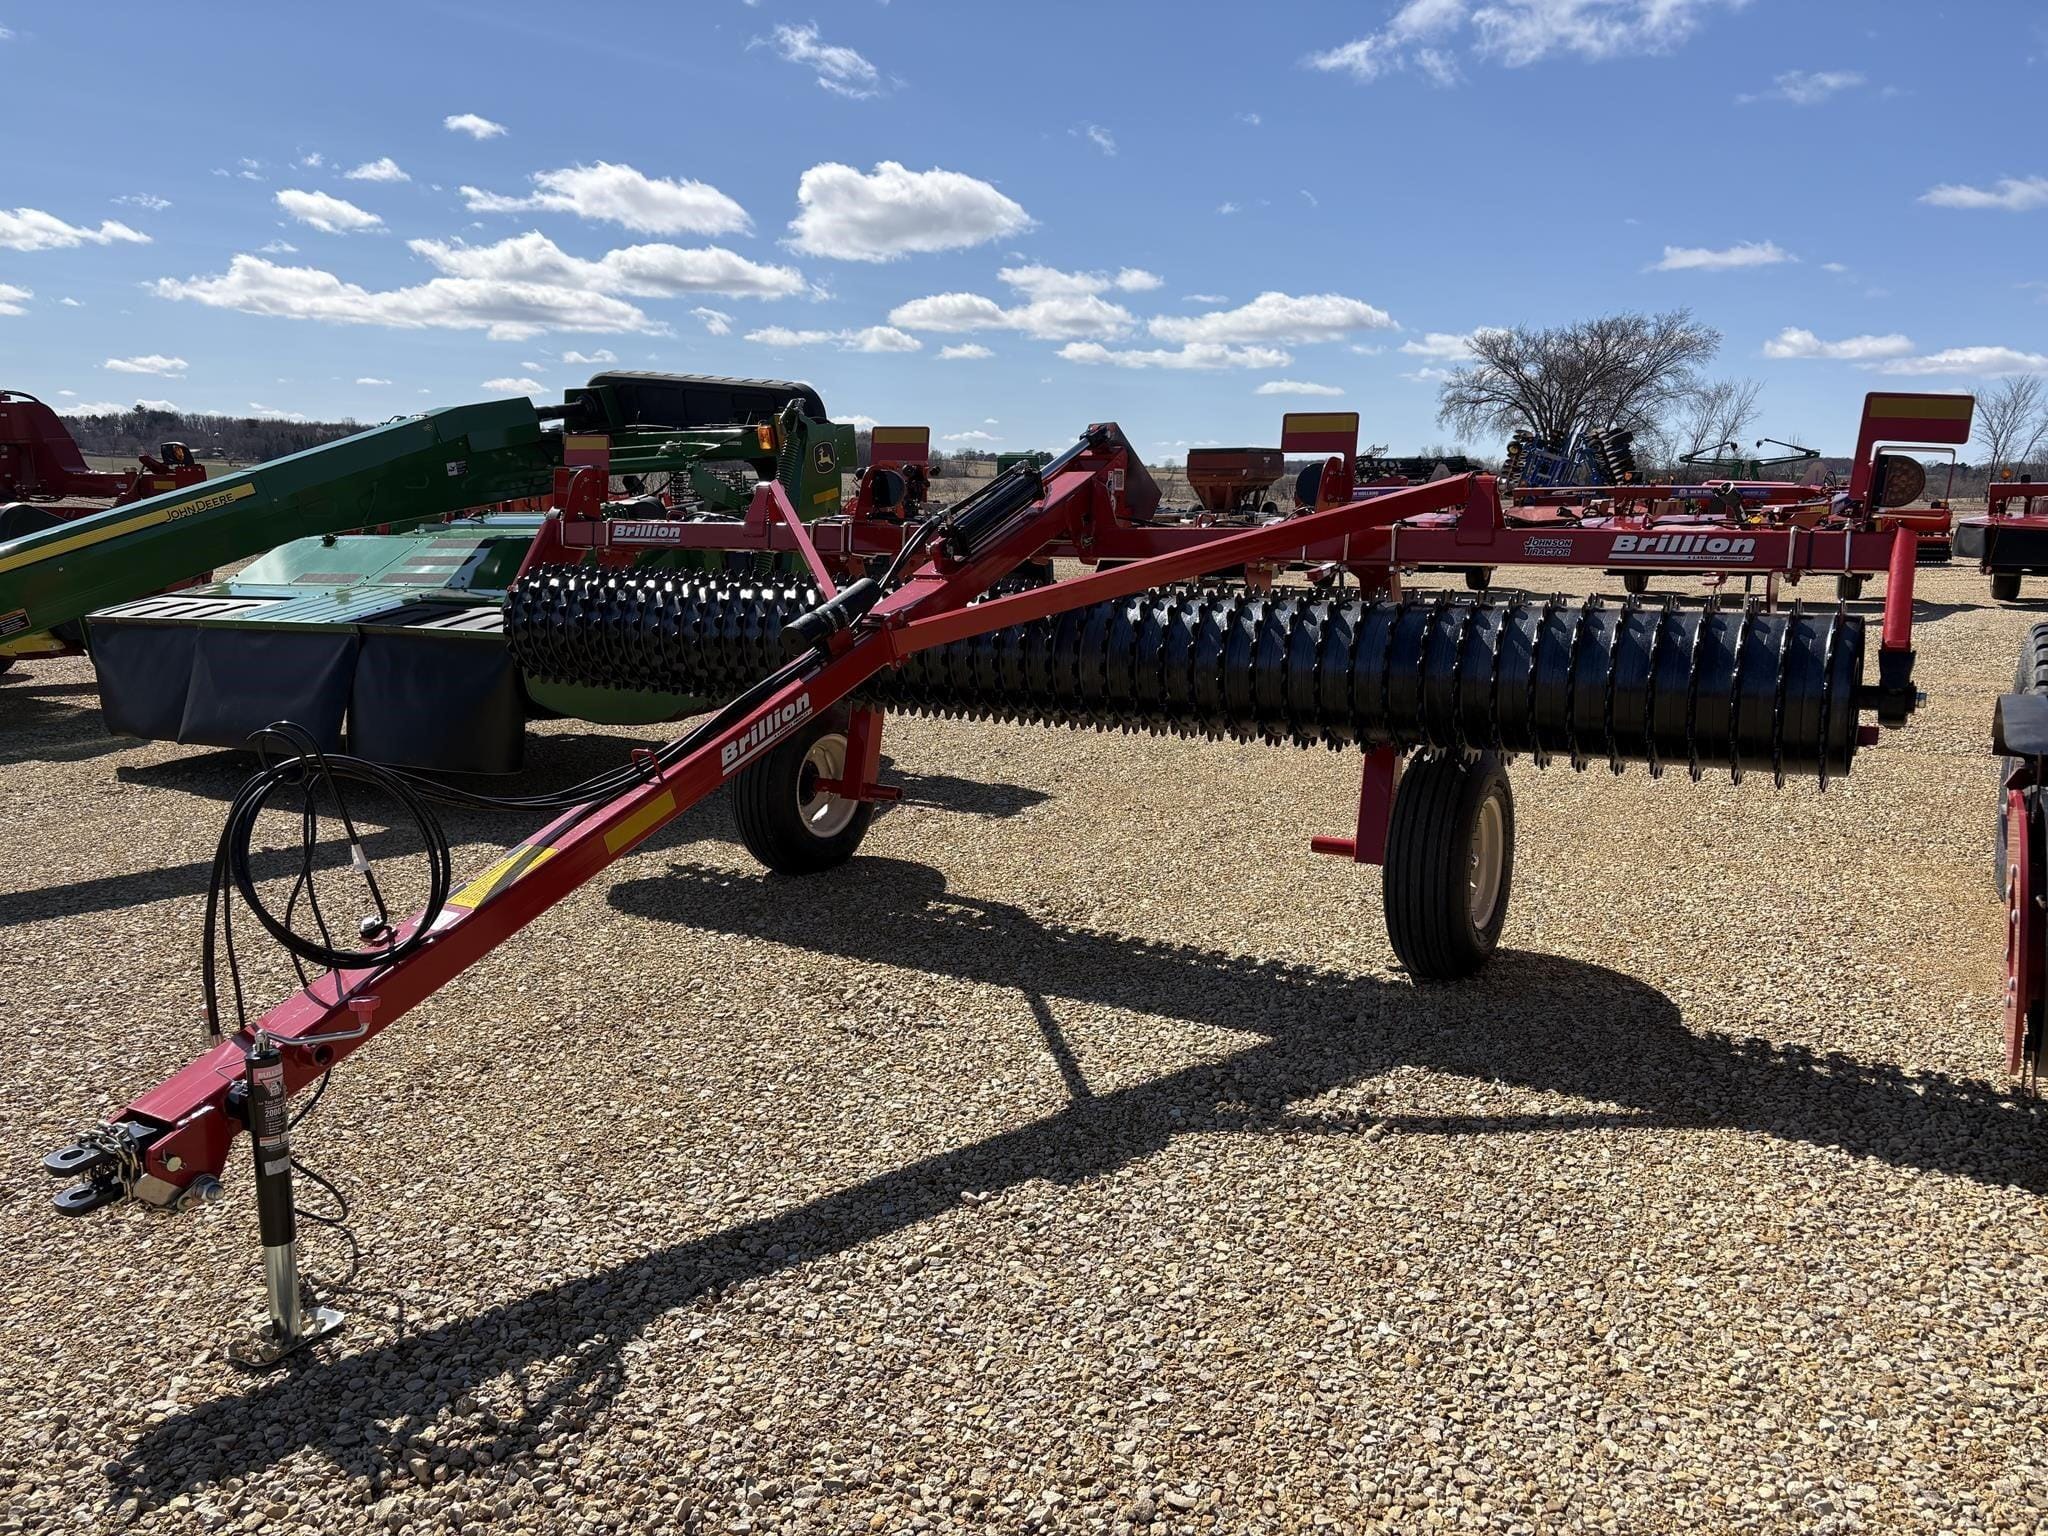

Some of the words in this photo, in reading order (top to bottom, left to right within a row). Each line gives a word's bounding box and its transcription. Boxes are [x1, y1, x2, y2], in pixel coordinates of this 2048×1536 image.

[166, 503, 197, 521] JOHN
[197, 493, 234, 511] DEERE
[613, 524, 680, 537] Brillion
[1524, 536, 1573, 547] JOHNSON
[1611, 534, 1756, 554] Brillion
[1524, 547, 1572, 556] TRACTOR
[721, 692, 809, 767] Brillion
